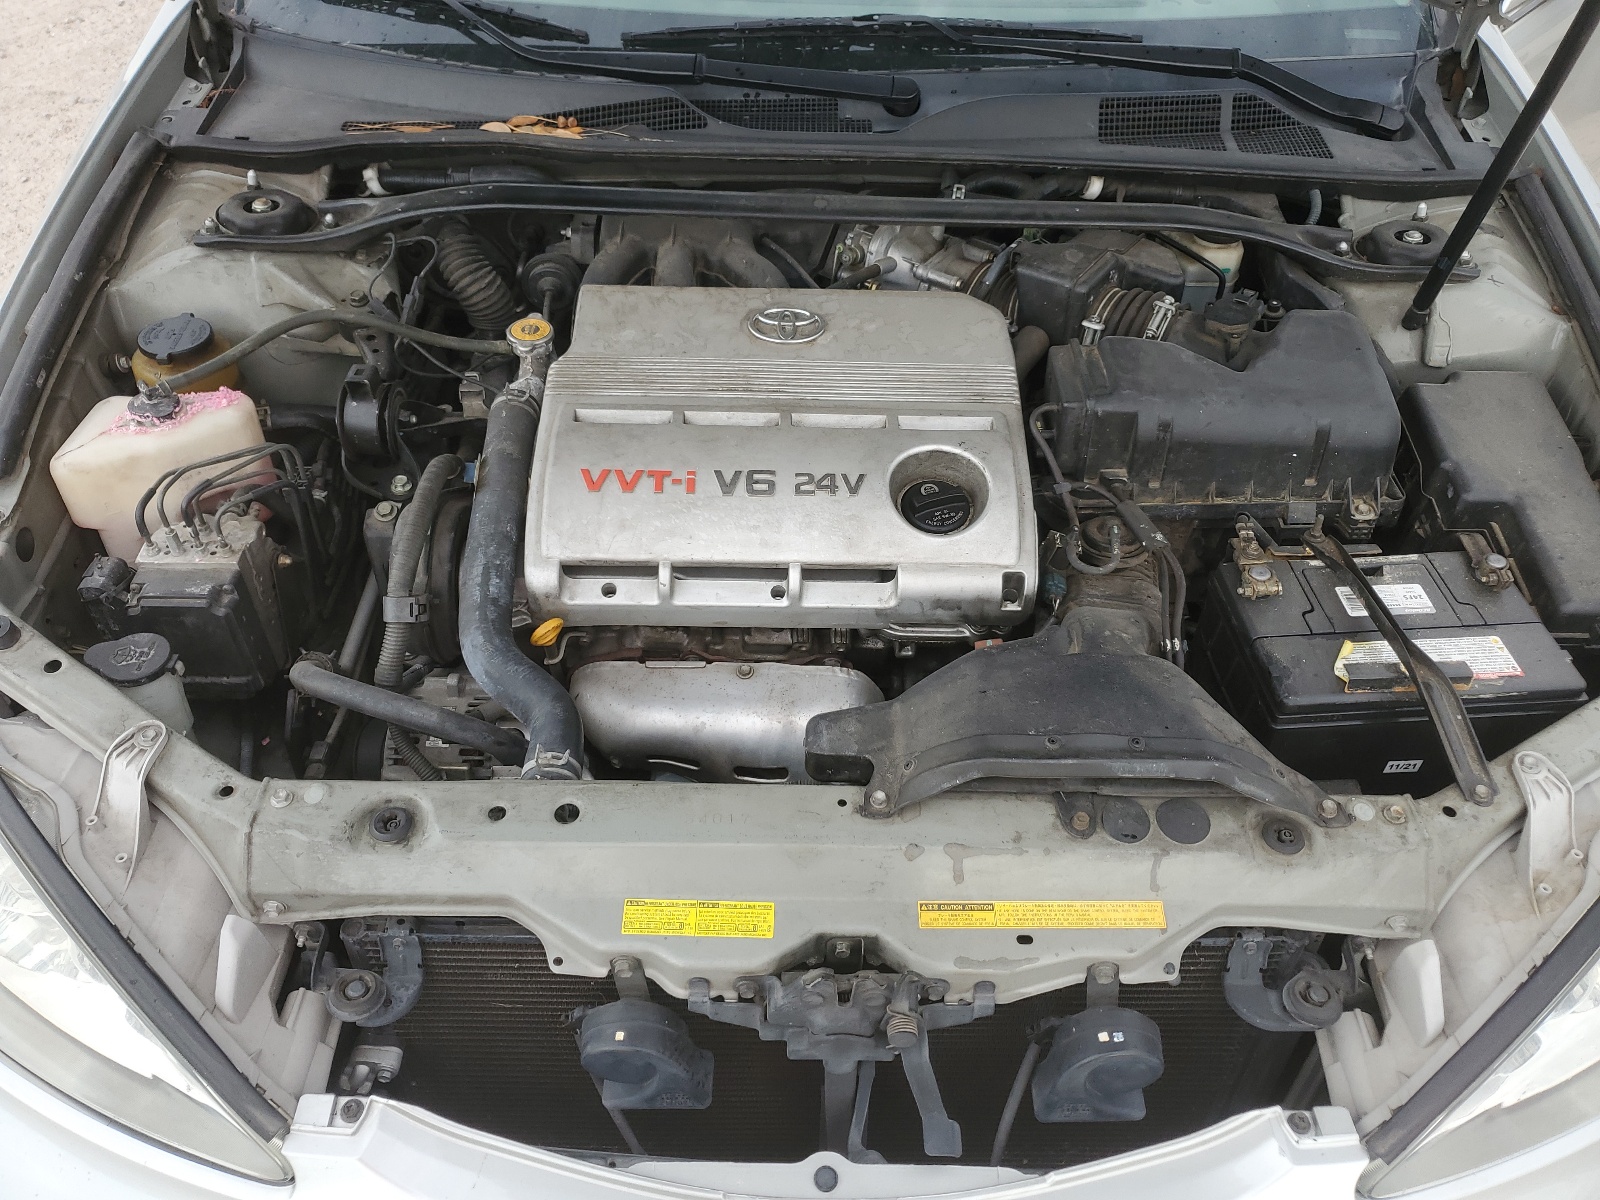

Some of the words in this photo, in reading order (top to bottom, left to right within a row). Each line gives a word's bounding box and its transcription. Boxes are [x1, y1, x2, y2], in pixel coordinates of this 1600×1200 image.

[580, 468, 697, 494] VVT-i
[714, 469, 777, 497] V6
[793, 472, 868, 497] 24V
[1388, 762, 1418, 771] 11/21
